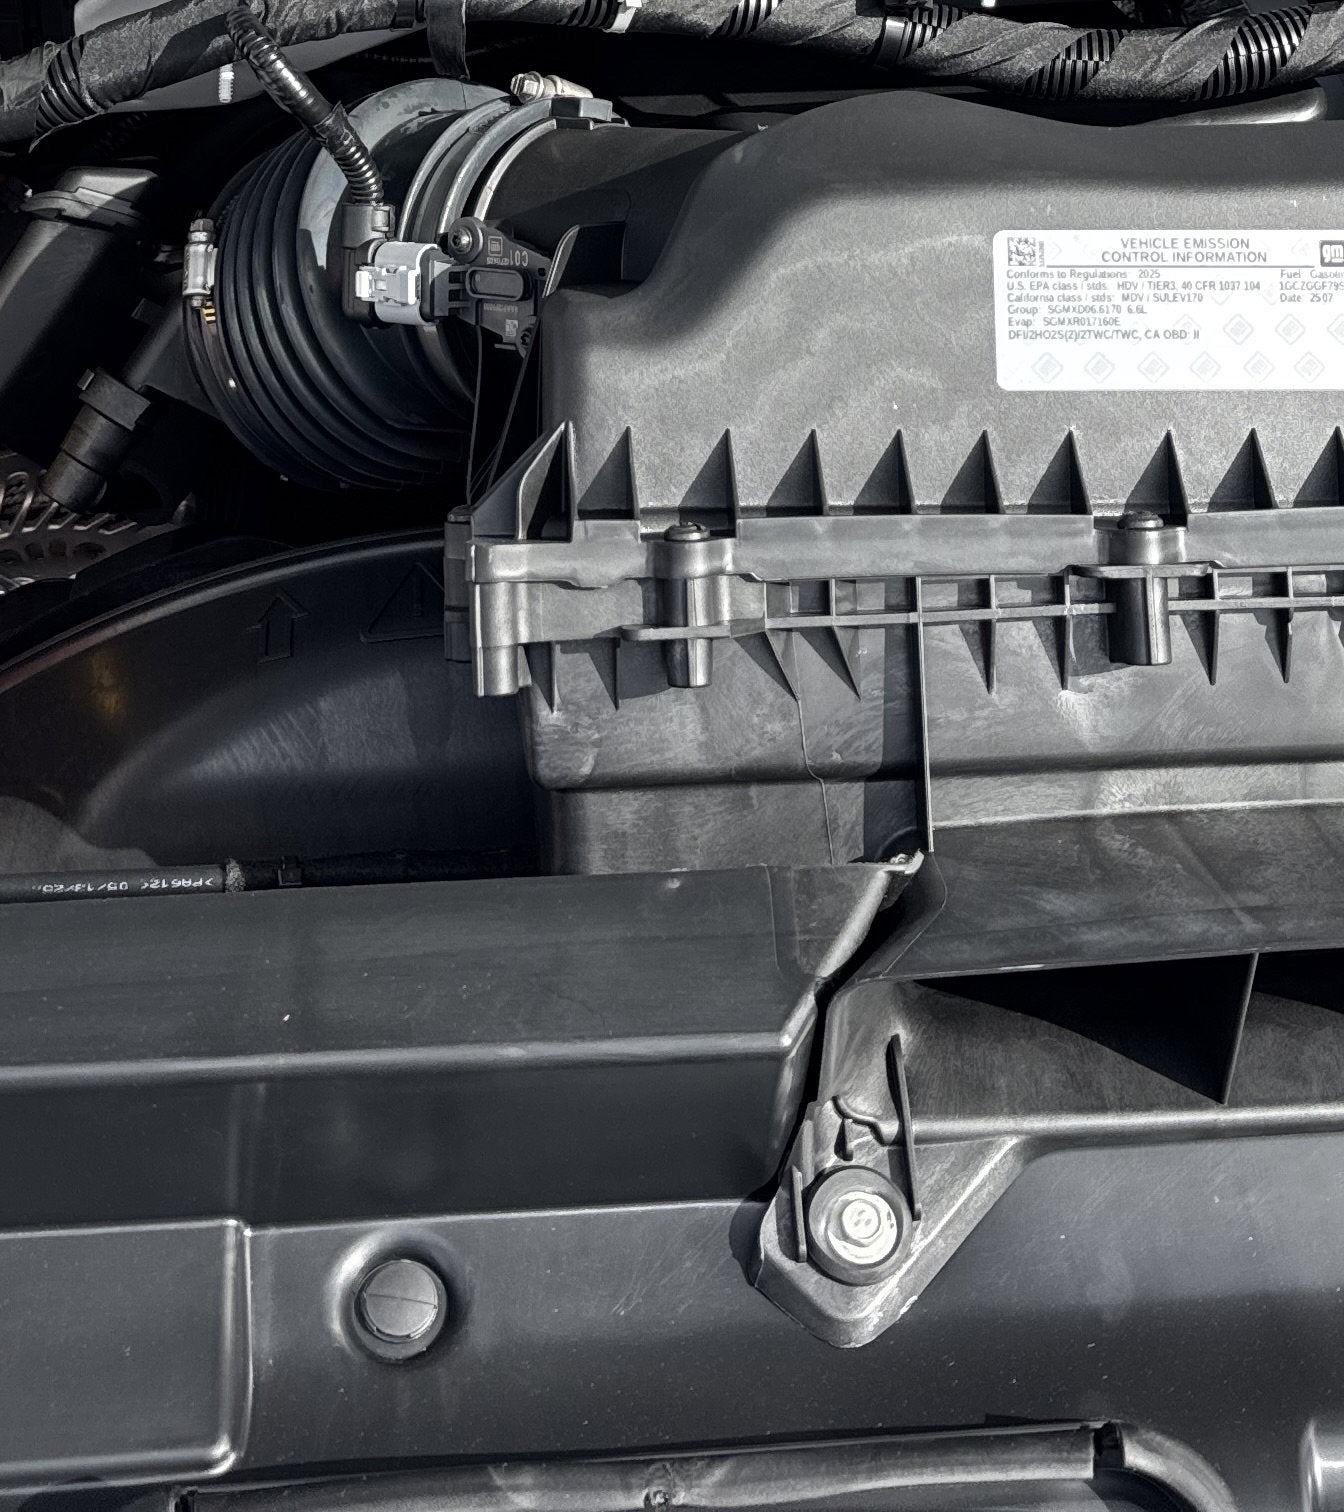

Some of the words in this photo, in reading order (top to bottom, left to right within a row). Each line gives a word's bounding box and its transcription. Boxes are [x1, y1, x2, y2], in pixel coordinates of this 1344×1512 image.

[1121, 238, 1179, 249] VEHICLE
[1184, 238, 1250, 249] EMISSION
[1101, 251, 1168, 262] CONTROL
[1173, 251, 1267, 262] INFORMATION
[1007, 270, 1054, 279] Conforms
[1057, 270, 1066, 279] to
[1138, 270, 1160, 279] 2025
[1030, 282, 1049, 290] EPA
[1053, 281, 1077, 290] class
[1117, 282, 1138, 290] HDV
[1181, 282, 1192, 290] 40
[1195, 282, 1216, 290] CFR
[1057, 293, 1082, 302] class
[1122, 293, 1144, 302] MDV
[1153, 293, 1203, 302] SULEV170
[1145, 330, 1160, 339] CA
